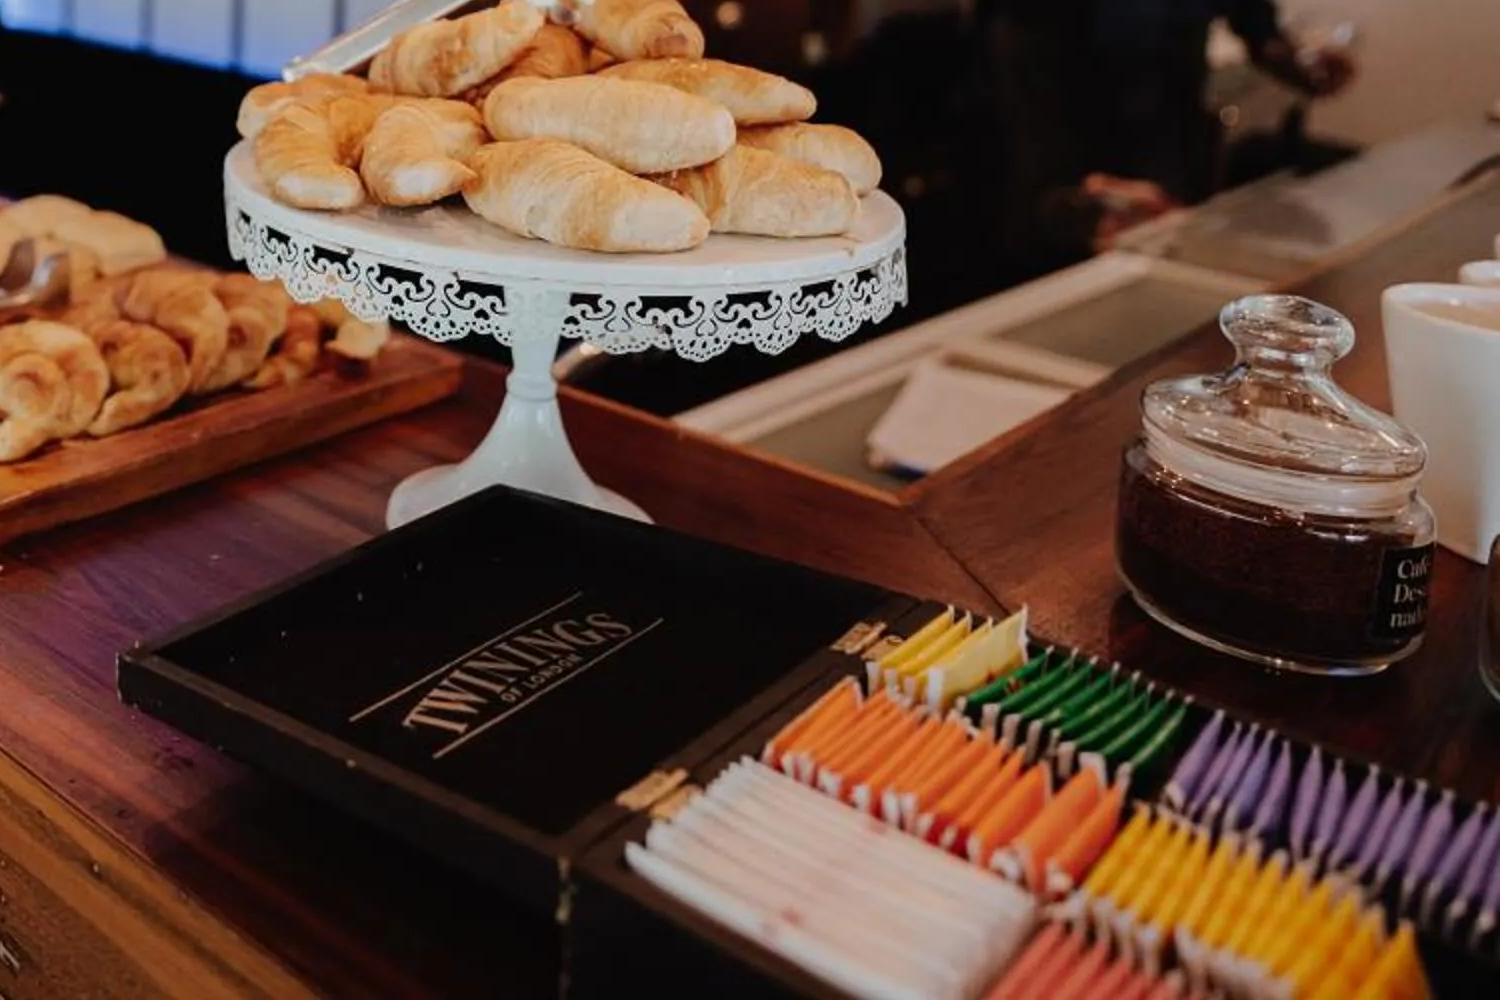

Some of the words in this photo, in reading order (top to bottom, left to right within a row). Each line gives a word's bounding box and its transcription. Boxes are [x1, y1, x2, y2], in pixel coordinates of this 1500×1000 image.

[402, 613, 632, 733] TWININGS
[501, 688, 523, 702] OF
[521, 653, 582, 690] LONDON
